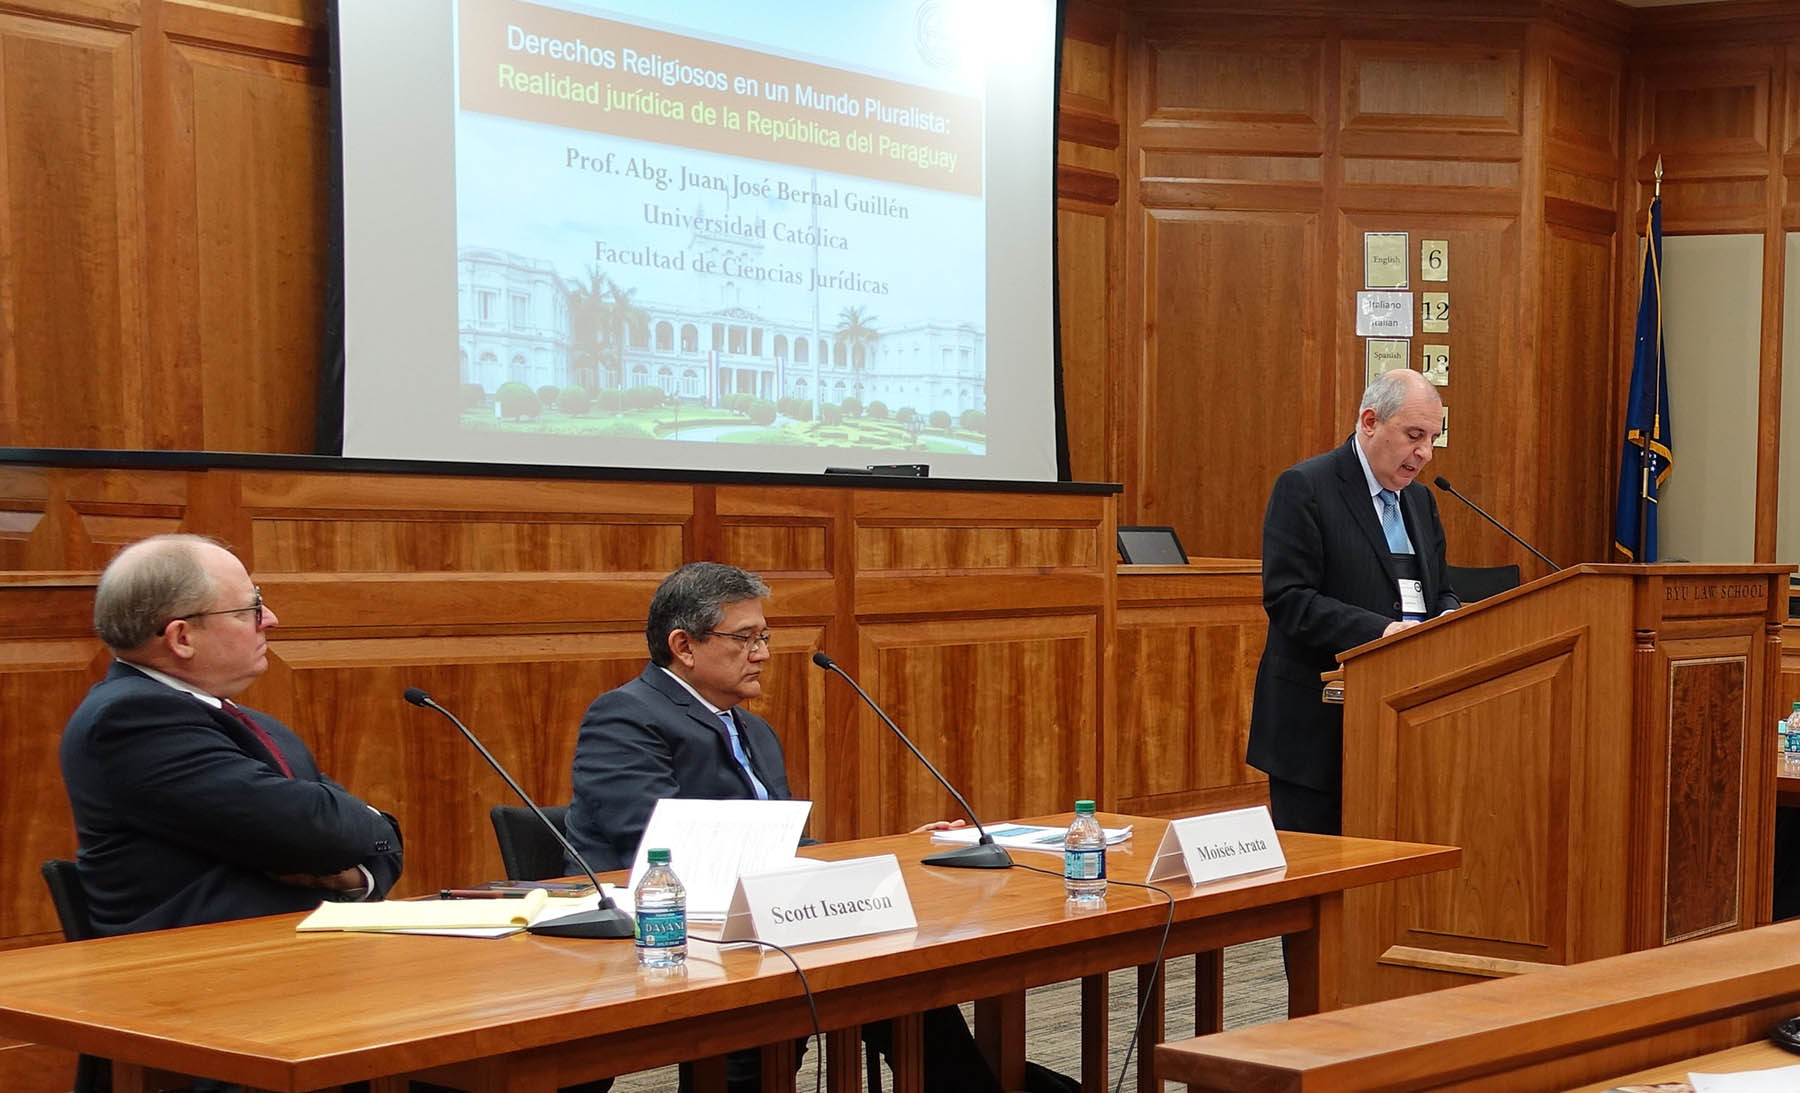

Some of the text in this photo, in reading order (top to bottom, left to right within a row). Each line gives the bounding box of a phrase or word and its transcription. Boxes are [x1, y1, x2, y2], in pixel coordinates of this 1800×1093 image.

[507, 24, 951, 135] Derechos Religiosos en un Mundo Pluralista:
[498, 63, 958, 173] Realidad jurídica de la República del Paraguay
[566, 147, 909, 220] Prof. Abg. Juan José Bernal Guillén
[643, 203, 849, 250] Universidad Católica
[595, 240, 889, 296] Facultad de Ciencias Jurídicas
[1373, 255, 1401, 265] English
[1428, 249, 1442, 269] 6
[1369, 300, 1402, 309] Italiano
[1422, 302, 1449, 320] 12
[1374, 351, 1402, 360] Spanish
[1666, 584, 1764, 600] BYU LAW SCHOOL
[1197, 838, 1267, 863] Moisés Arata
[770, 893, 893, 925] Scott Isaacson
